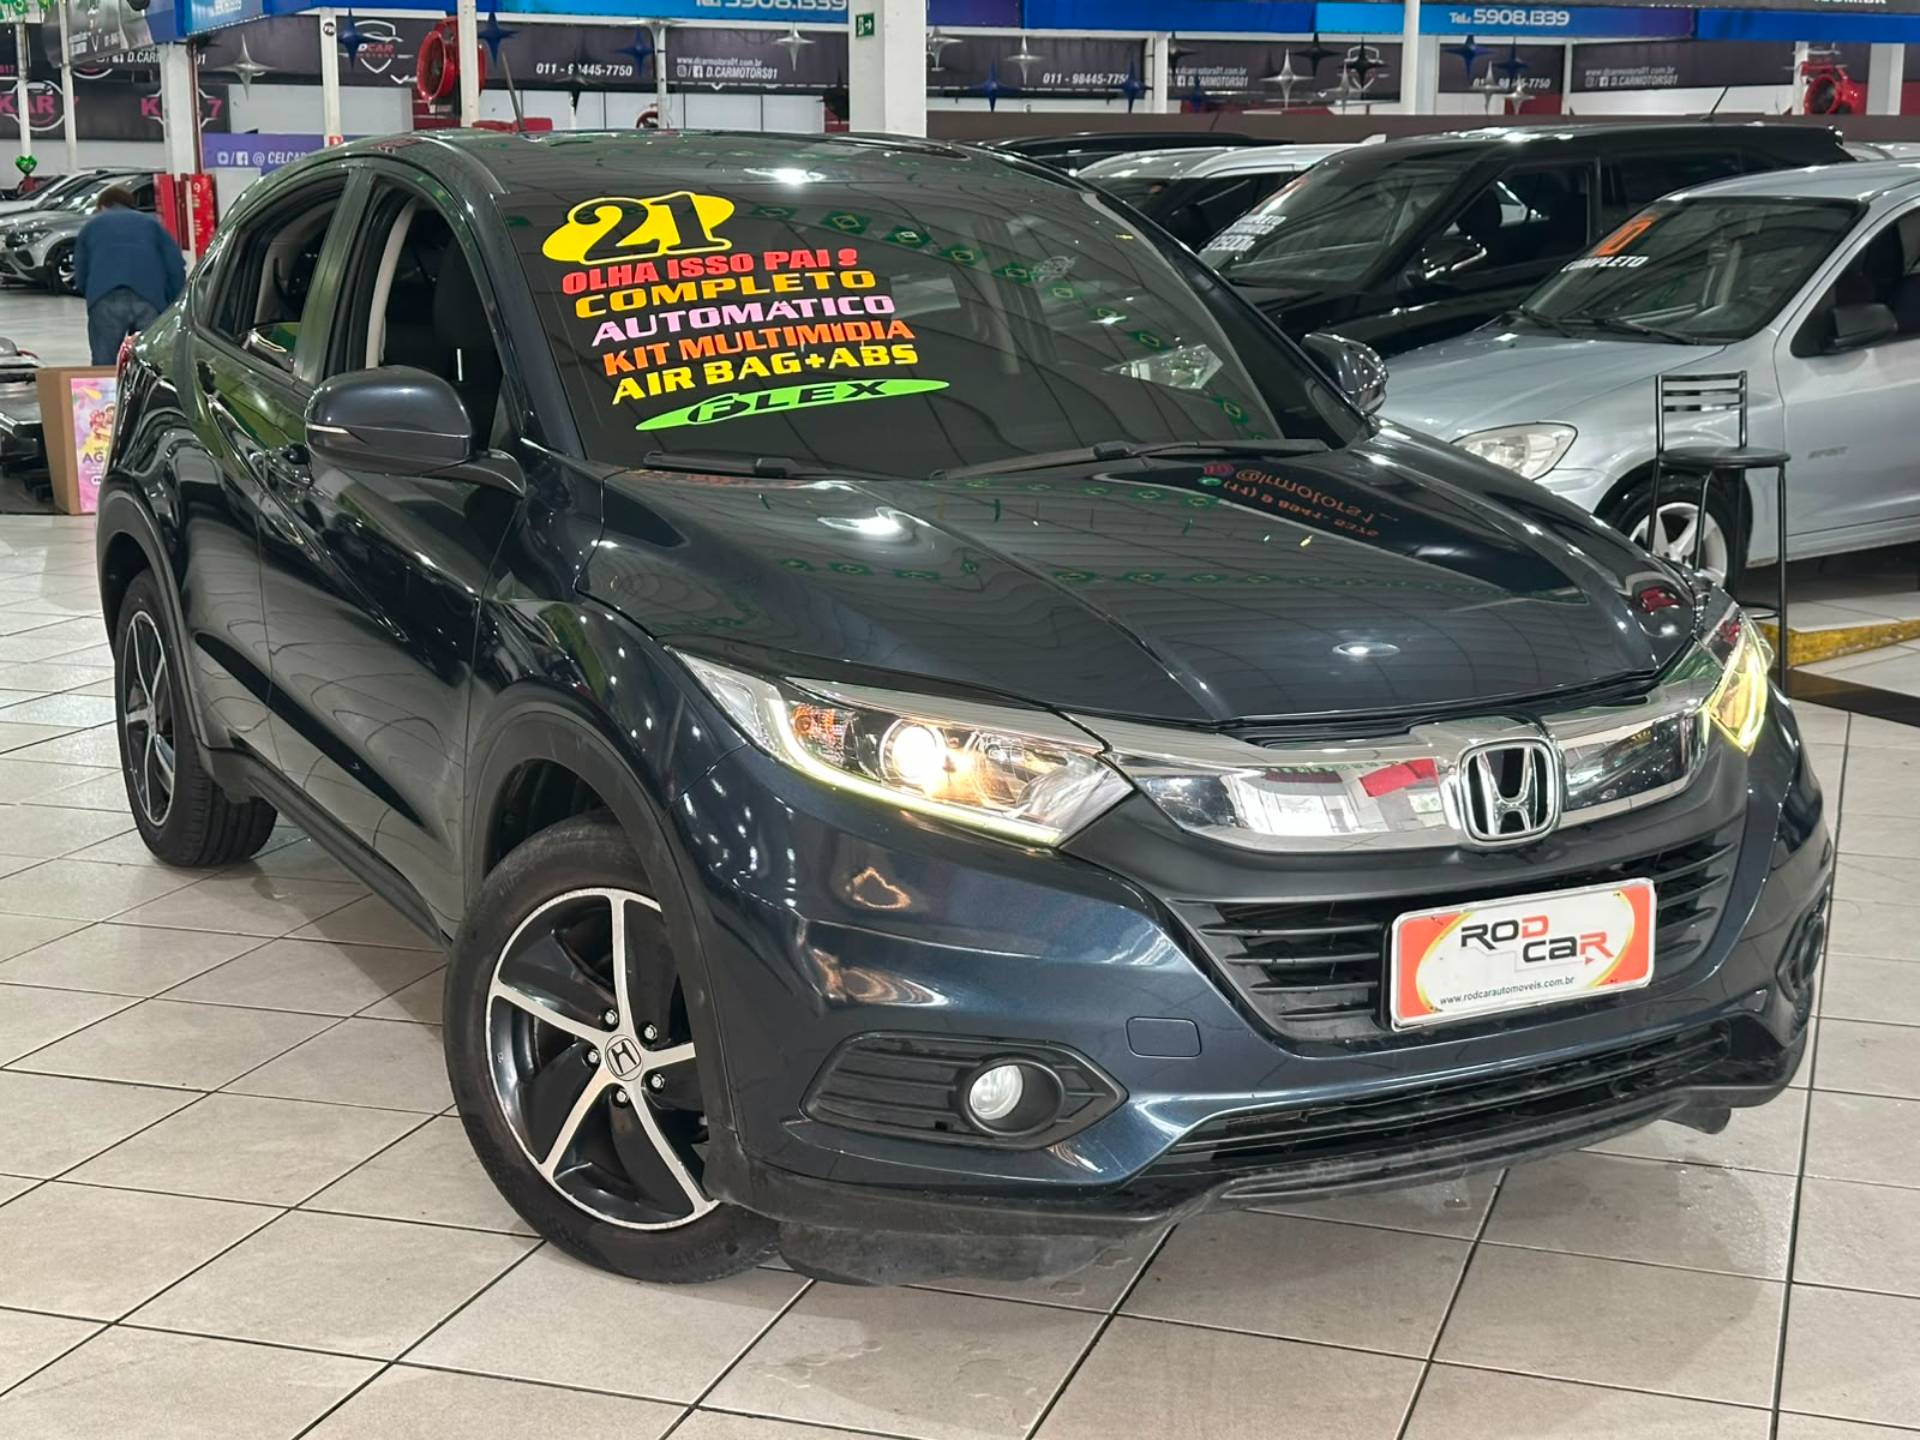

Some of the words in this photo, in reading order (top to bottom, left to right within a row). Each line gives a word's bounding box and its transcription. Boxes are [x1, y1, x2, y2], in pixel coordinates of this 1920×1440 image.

[536, 63, 557, 74] 011
[567, 63, 633, 76] 9445-7750
[706, 66, 778, 79] D.CARMOTORS01
[1043, 72, 1063, 84] 011
[1072, 72, 1130, 85] 98445-775
[570, 193, 731, 264] 21
[563, 261, 660, 295] OLHA
[666, 252, 755, 280] ISSO
[763, 248, 831, 270] PAI
[1560, 255, 1649, 273] COMPLETO
[575, 270, 876, 319] COMPLETO
[602, 341, 671, 376] KIT
[612, 366, 696, 405] AIR
[703, 344, 919, 386] BAG+ABS
[690, 379, 891, 424] FLEX
[1460, 914, 1549, 951] ROD
[1439, 976, 1575, 1006] www.rodcarautomoveis.com.br
